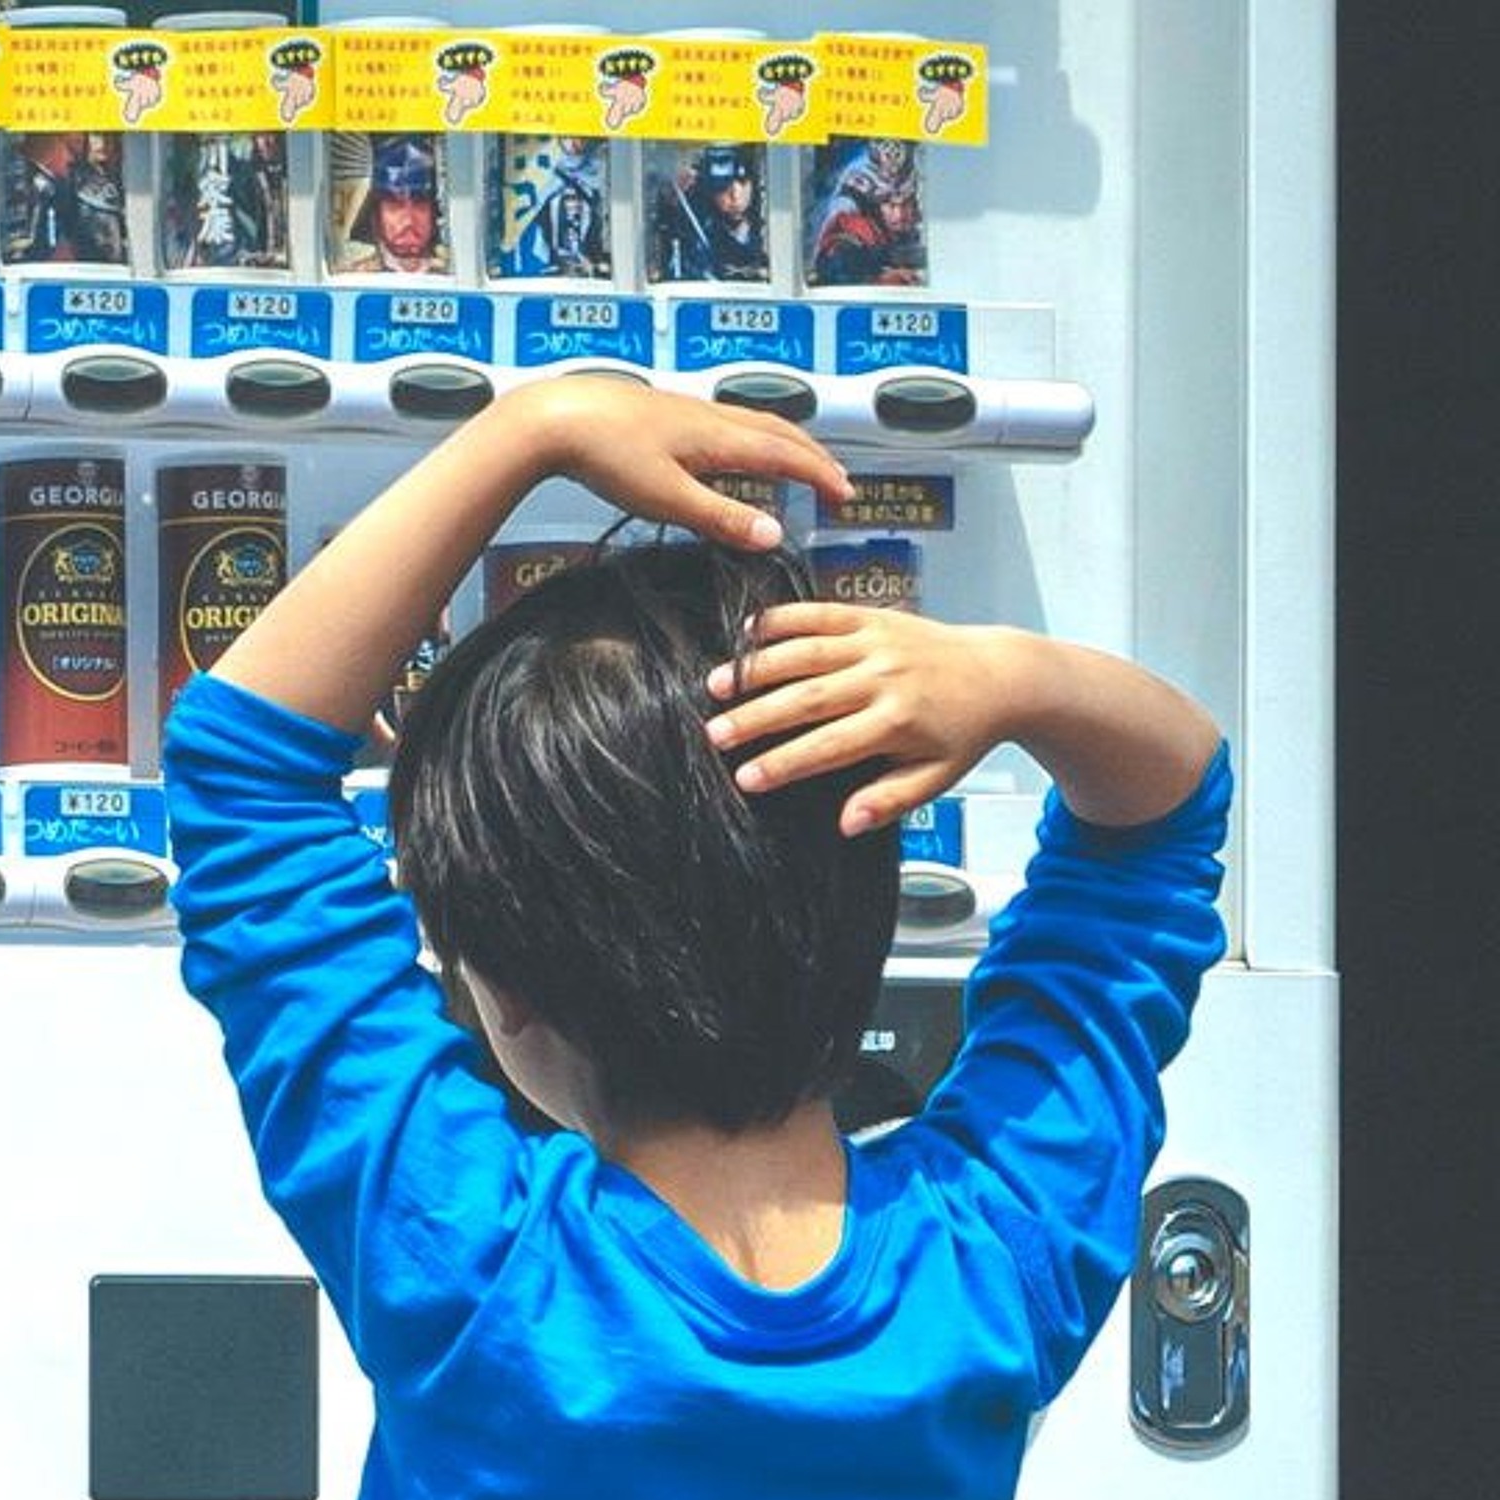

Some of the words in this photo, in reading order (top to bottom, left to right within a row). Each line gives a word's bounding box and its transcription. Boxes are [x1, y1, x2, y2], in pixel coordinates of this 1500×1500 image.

[70, 292, 126, 310] ¥120
[236, 296, 290, 315] ¥120
[398, 300, 453, 318] ¥120
[558, 305, 612, 324] ¥120
[719, 309, 773, 328] ¥120
[878, 313, 931, 332] ¥120
[69, 794, 123, 812] ¥120
